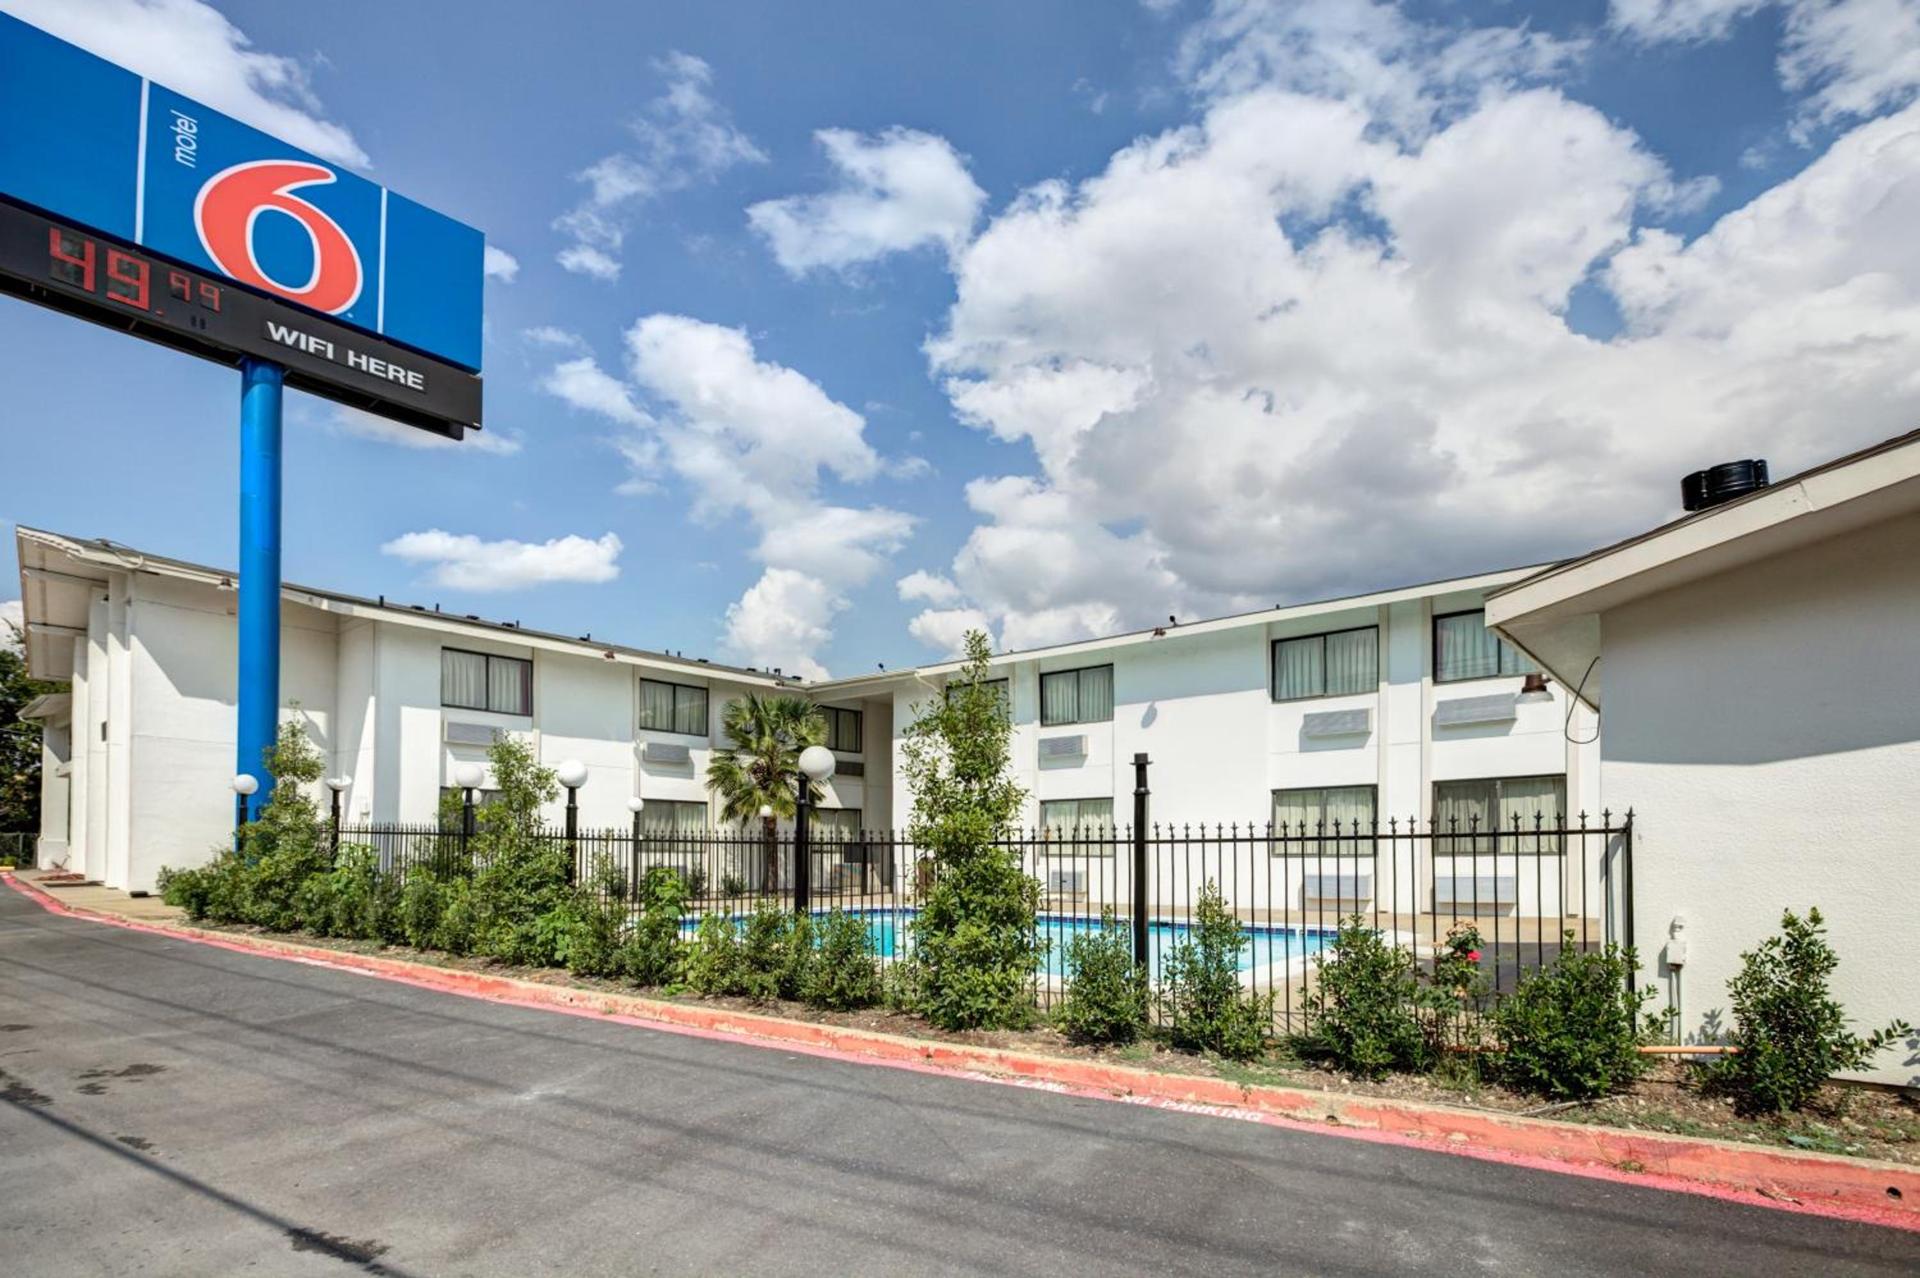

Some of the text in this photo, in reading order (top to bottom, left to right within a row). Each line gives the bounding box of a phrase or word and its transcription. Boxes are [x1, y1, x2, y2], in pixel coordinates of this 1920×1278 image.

[170, 109, 198, 168] motel
[193, 159, 363, 315] 6
[266, 321, 424, 391] WIFI HERE
[1159, 1100, 1262, 1122] PARKING
